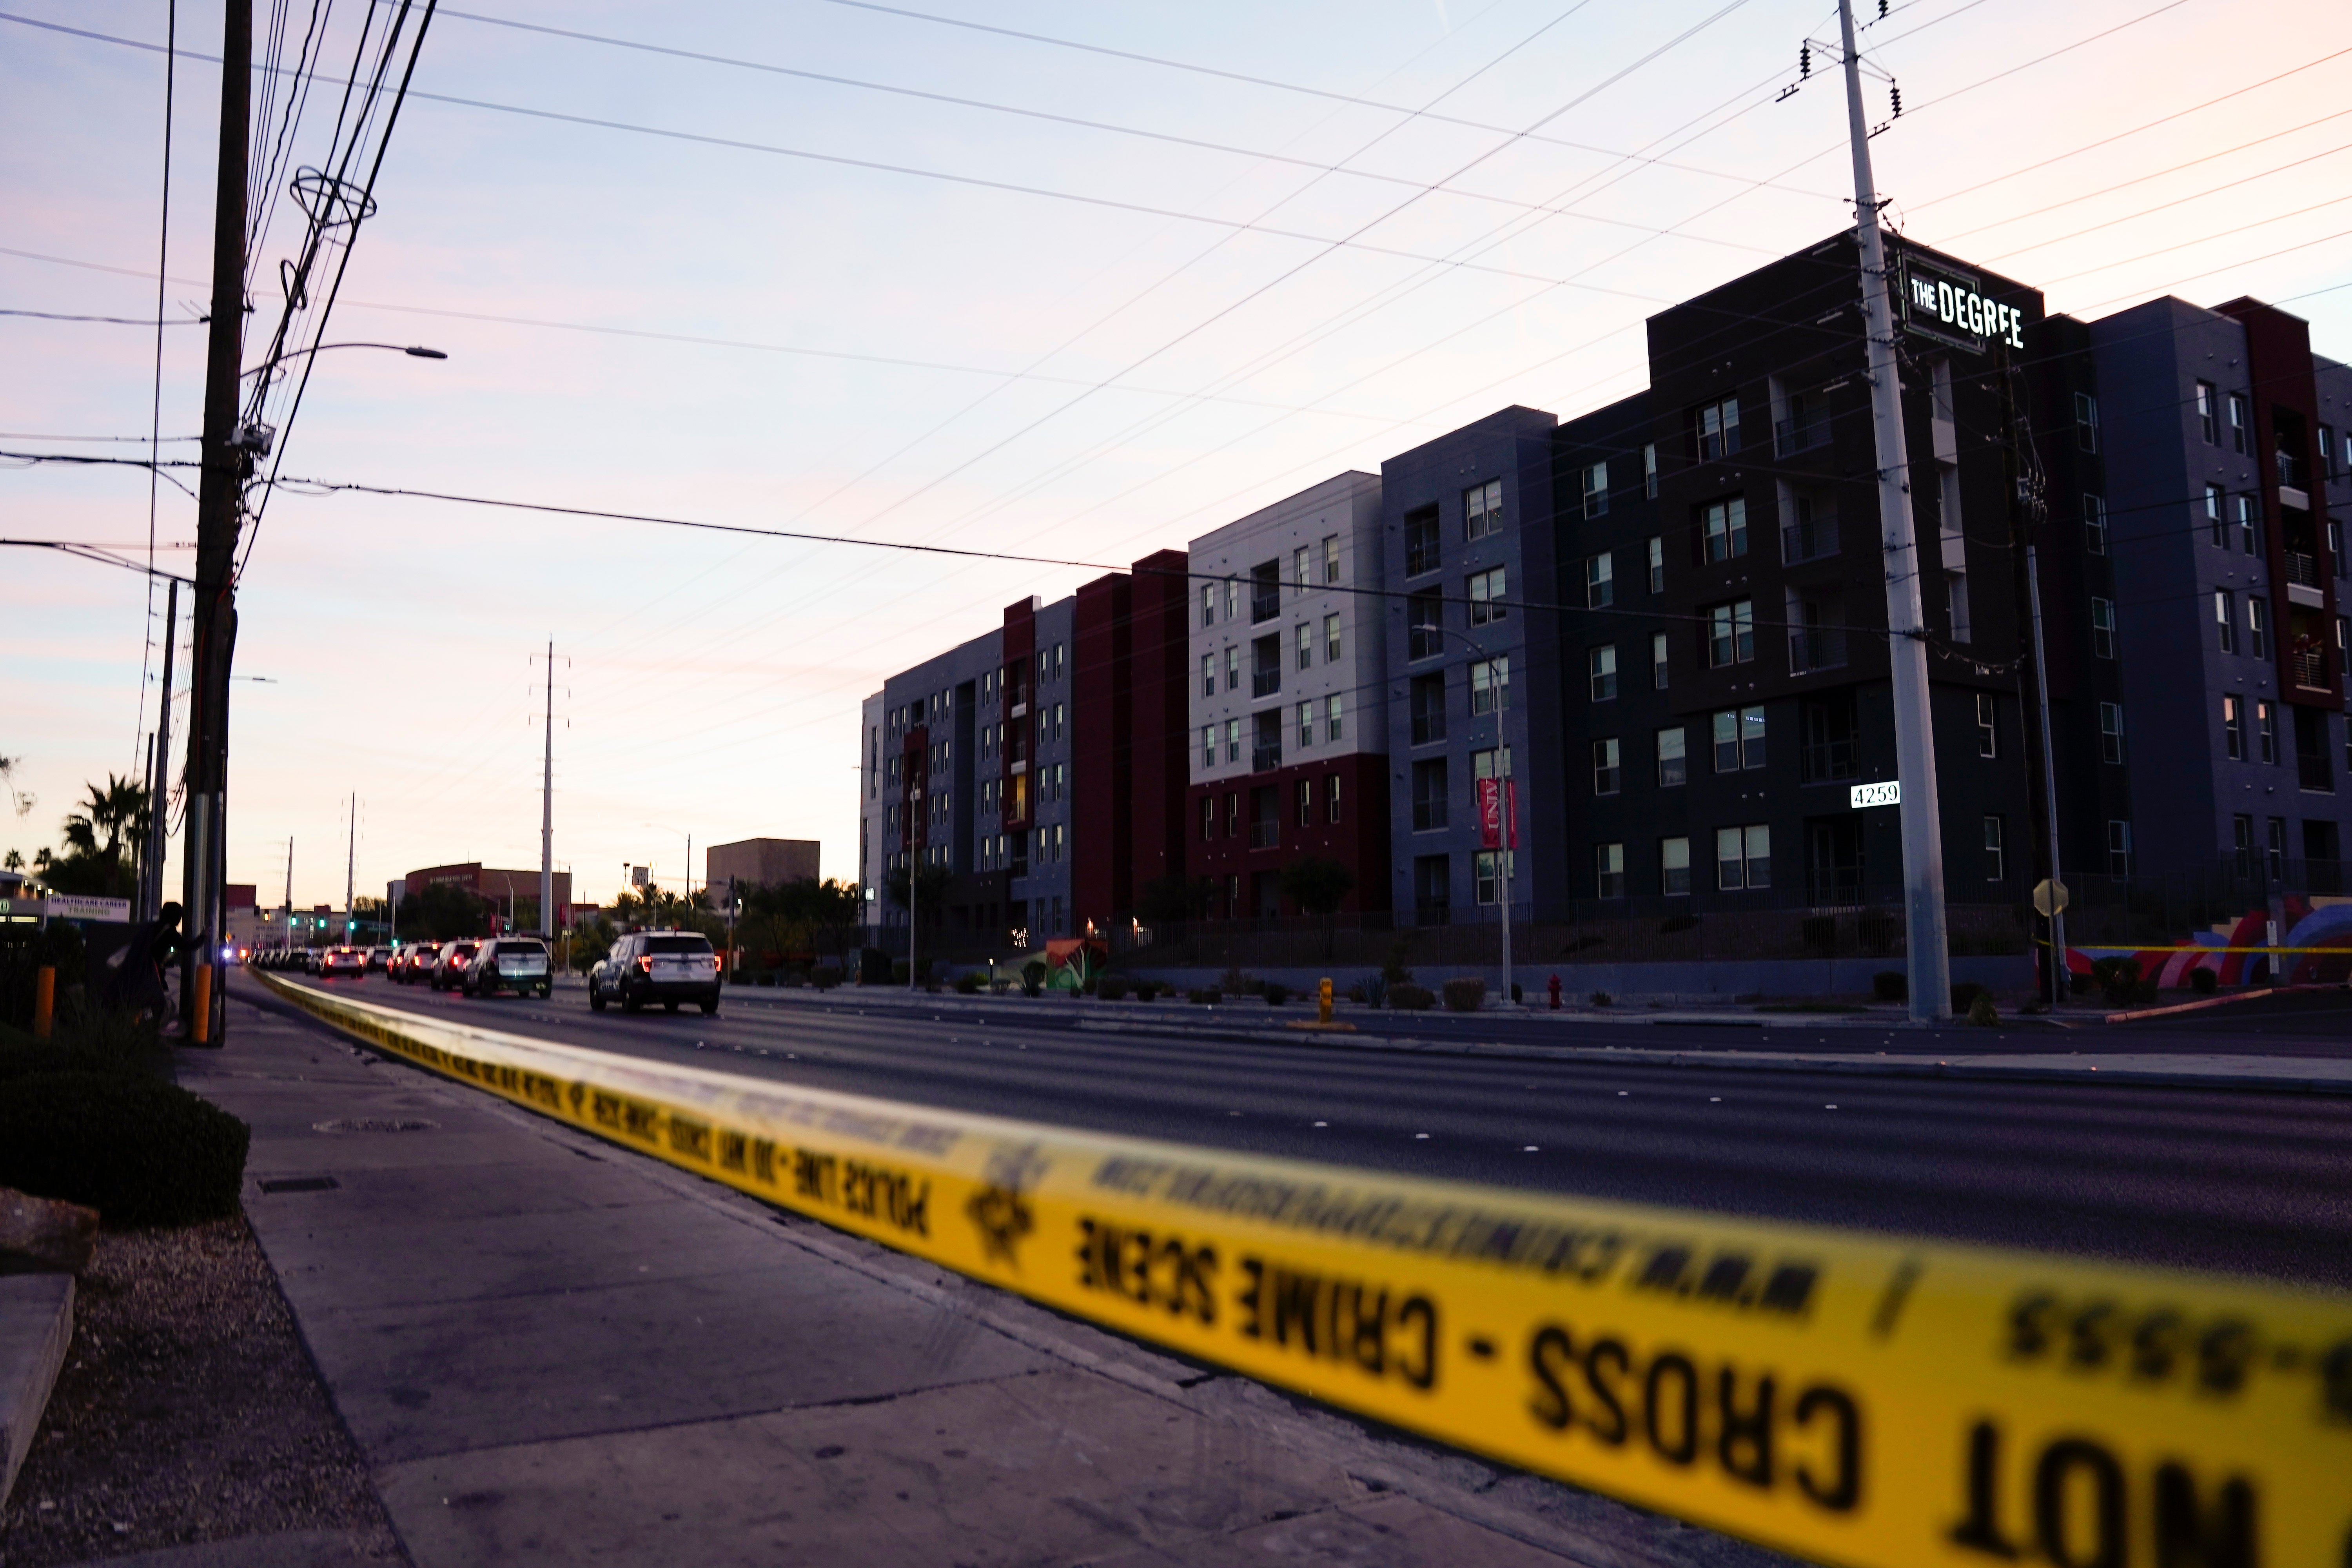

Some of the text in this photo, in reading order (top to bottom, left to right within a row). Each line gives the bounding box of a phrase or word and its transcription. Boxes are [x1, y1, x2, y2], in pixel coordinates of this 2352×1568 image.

[1911, 278, 2024, 349] THE DEGREE
[1855, 785, 1898, 804] 4259
[1077, 1213, 1216, 1325] SCENE
[1241, 1254, 1438, 1392] CRIME
[1528, 1319, 1861, 1515] CROSS
[1945, 1415, 2260, 1568] NOT
